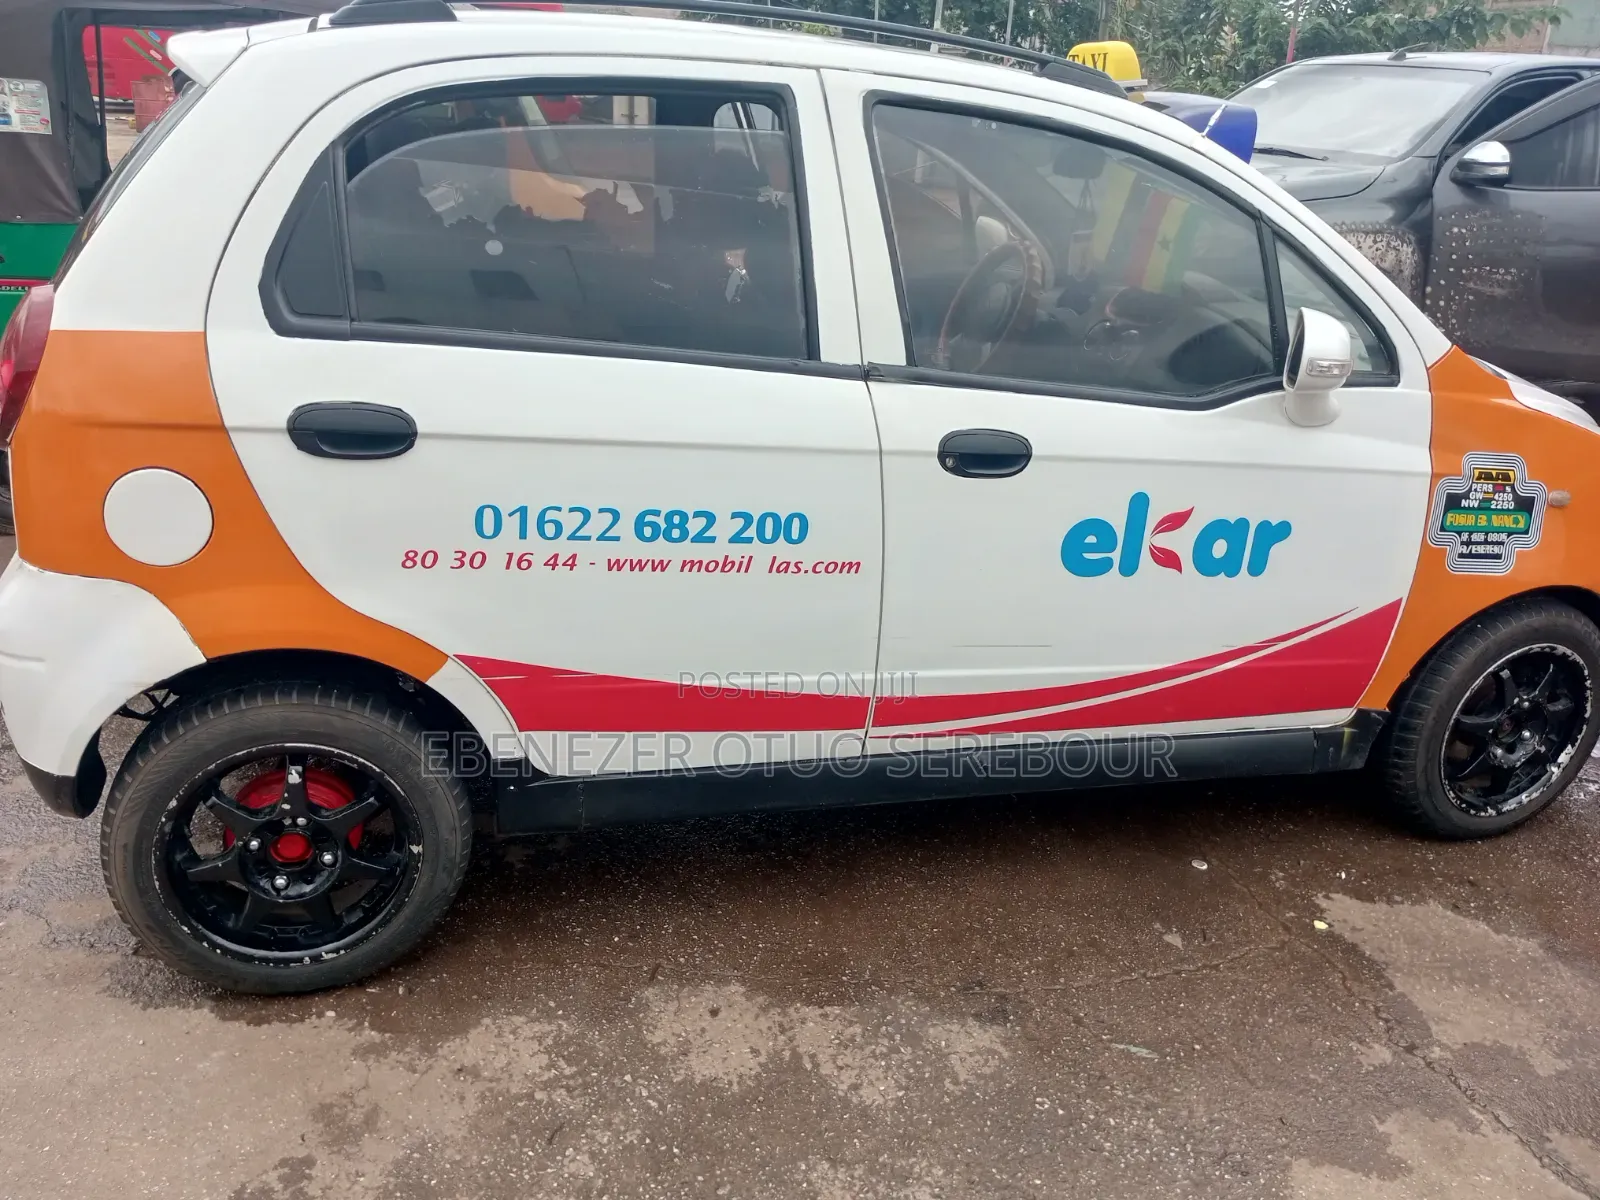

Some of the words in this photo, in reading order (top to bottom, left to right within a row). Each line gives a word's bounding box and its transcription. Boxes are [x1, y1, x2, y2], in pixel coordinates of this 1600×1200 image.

[1471, 483, 1493, 492] PERS
[1469, 491, 1483, 500] GW
[1493, 492, 1513, 501] 4250
[1460, 499, 1480, 508] NW
[1490, 500, 1515, 509] 2250
[474, 503, 622, 542] 01622
[633, 508, 718, 544] 682
[727, 510, 809, 545] 200
[400, 549, 439, 570] 80
[449, 550, 488, 570] 30
[504, 551, 535, 571] 16
[543, 552, 578, 571] 44
[607, 557, 672, 573] www
[679, 554, 754, 574] mobil
[767, 555, 862, 575] las.com
